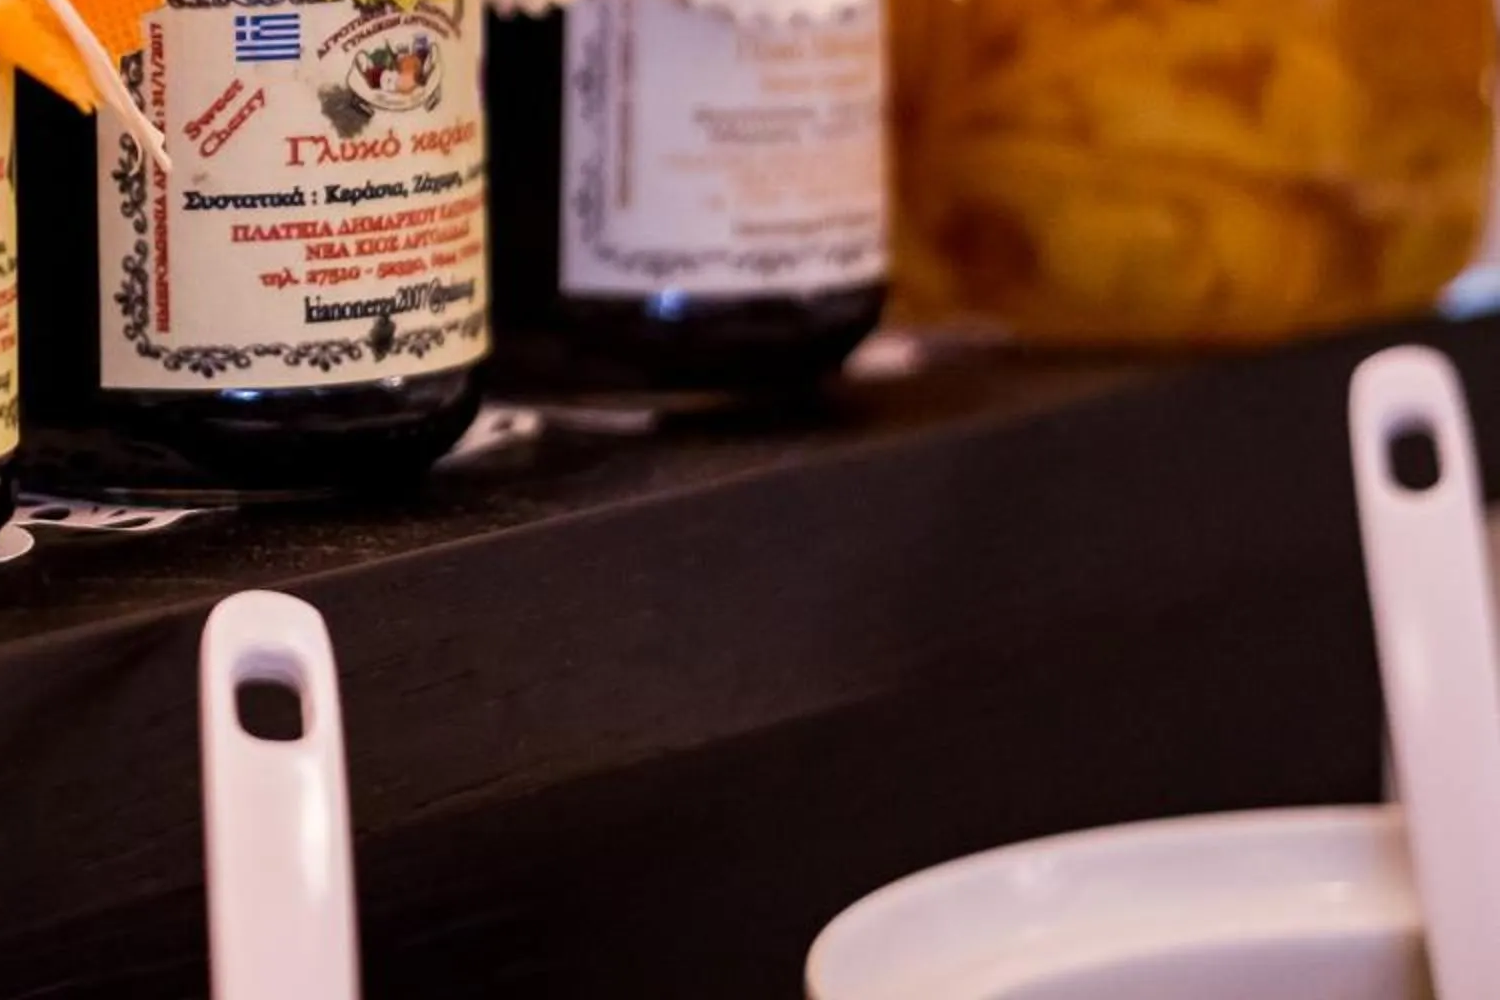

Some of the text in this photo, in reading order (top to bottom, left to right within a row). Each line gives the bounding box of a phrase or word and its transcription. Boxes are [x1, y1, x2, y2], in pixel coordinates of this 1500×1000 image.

[183, 78, 244, 141] Sweet
[199, 87, 266, 158] Cherry
[286, 128, 402, 167] Γλυκό
[183, 185, 305, 211] Συστατικά
[324, 179, 409, 206] Κεράσια,
[231, 220, 333, 243] ΠΛΑΤΕΙΑ
[305, 243, 350, 261] ΝΕΑ
[354, 236, 399, 257] ΚΙΟΣ
